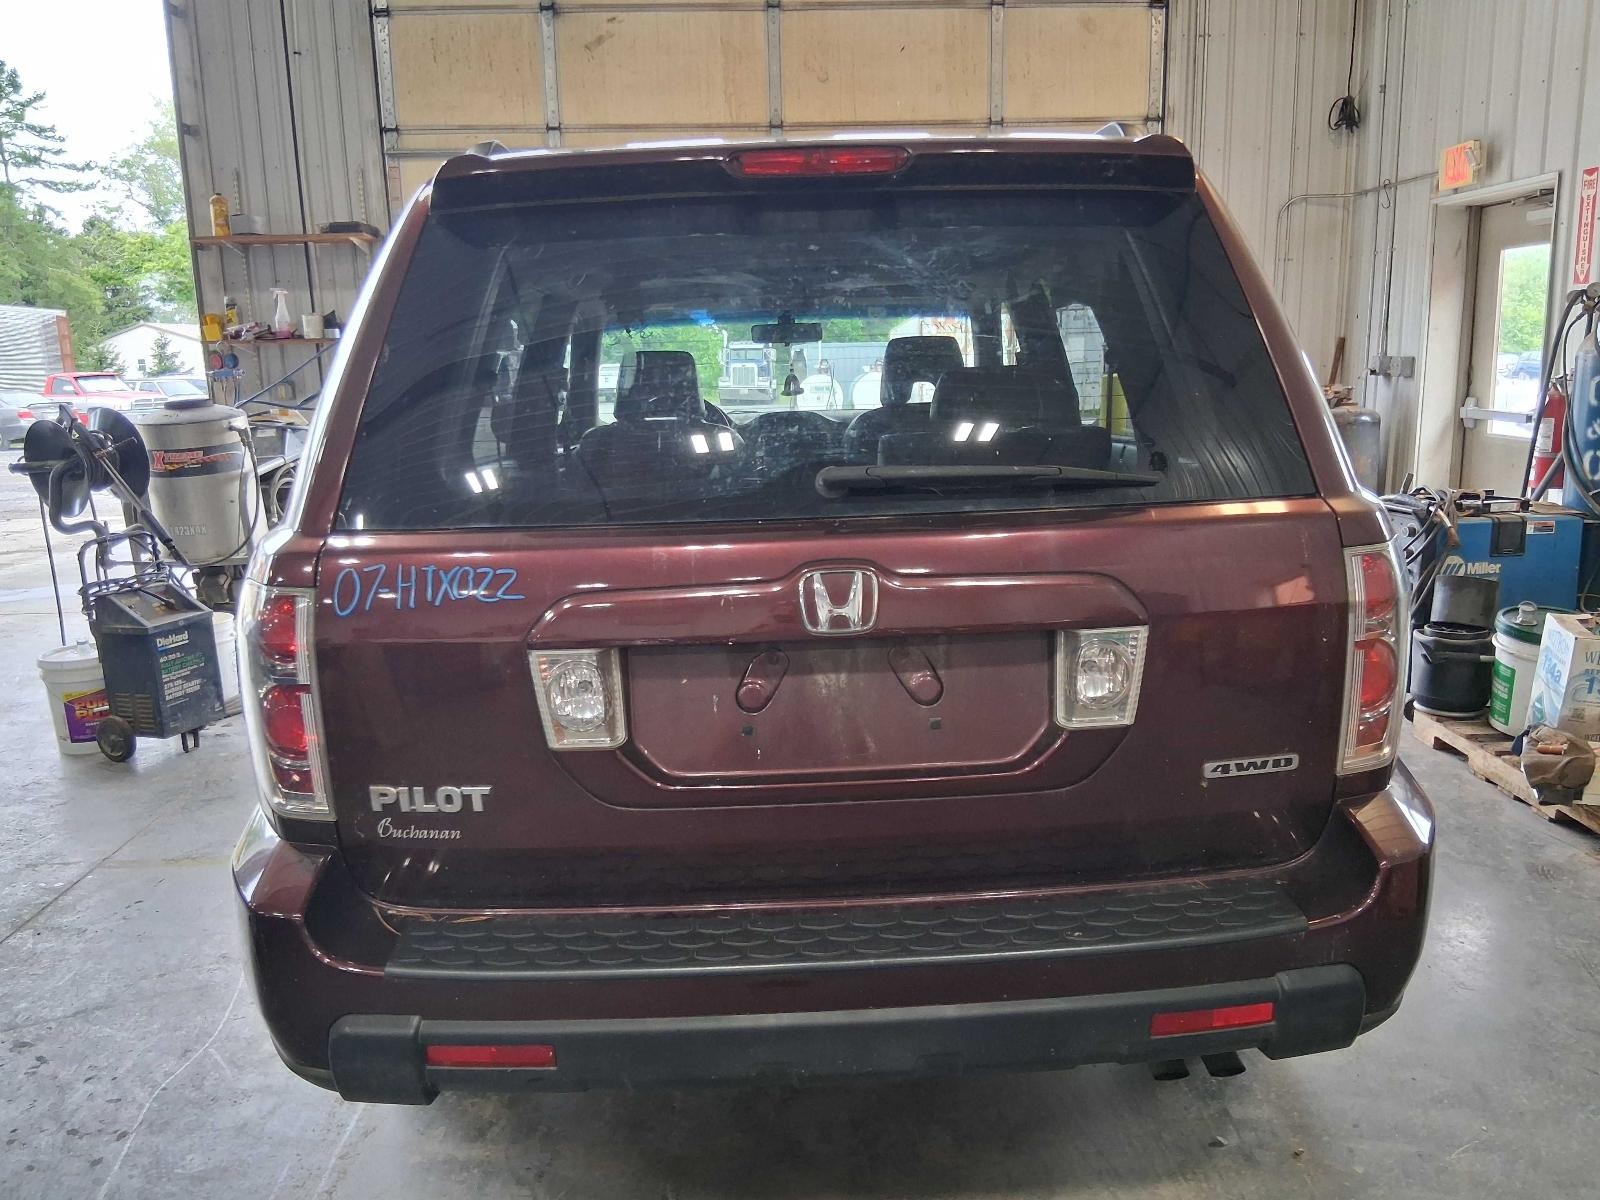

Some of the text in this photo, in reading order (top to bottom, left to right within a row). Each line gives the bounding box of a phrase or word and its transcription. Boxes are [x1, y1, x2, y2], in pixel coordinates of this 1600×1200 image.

[1583, 178, 1596, 190] FIRE
[1580, 194, 1591, 275] EXTINGUISHER
[1467, 562, 1501, 575] Miller
[156, 630, 189, 648] DieHard
[1210, 757, 1294, 775] 4WD
[369, 785, 493, 813] PILOT
[378, 817, 462, 839] Buchanan
